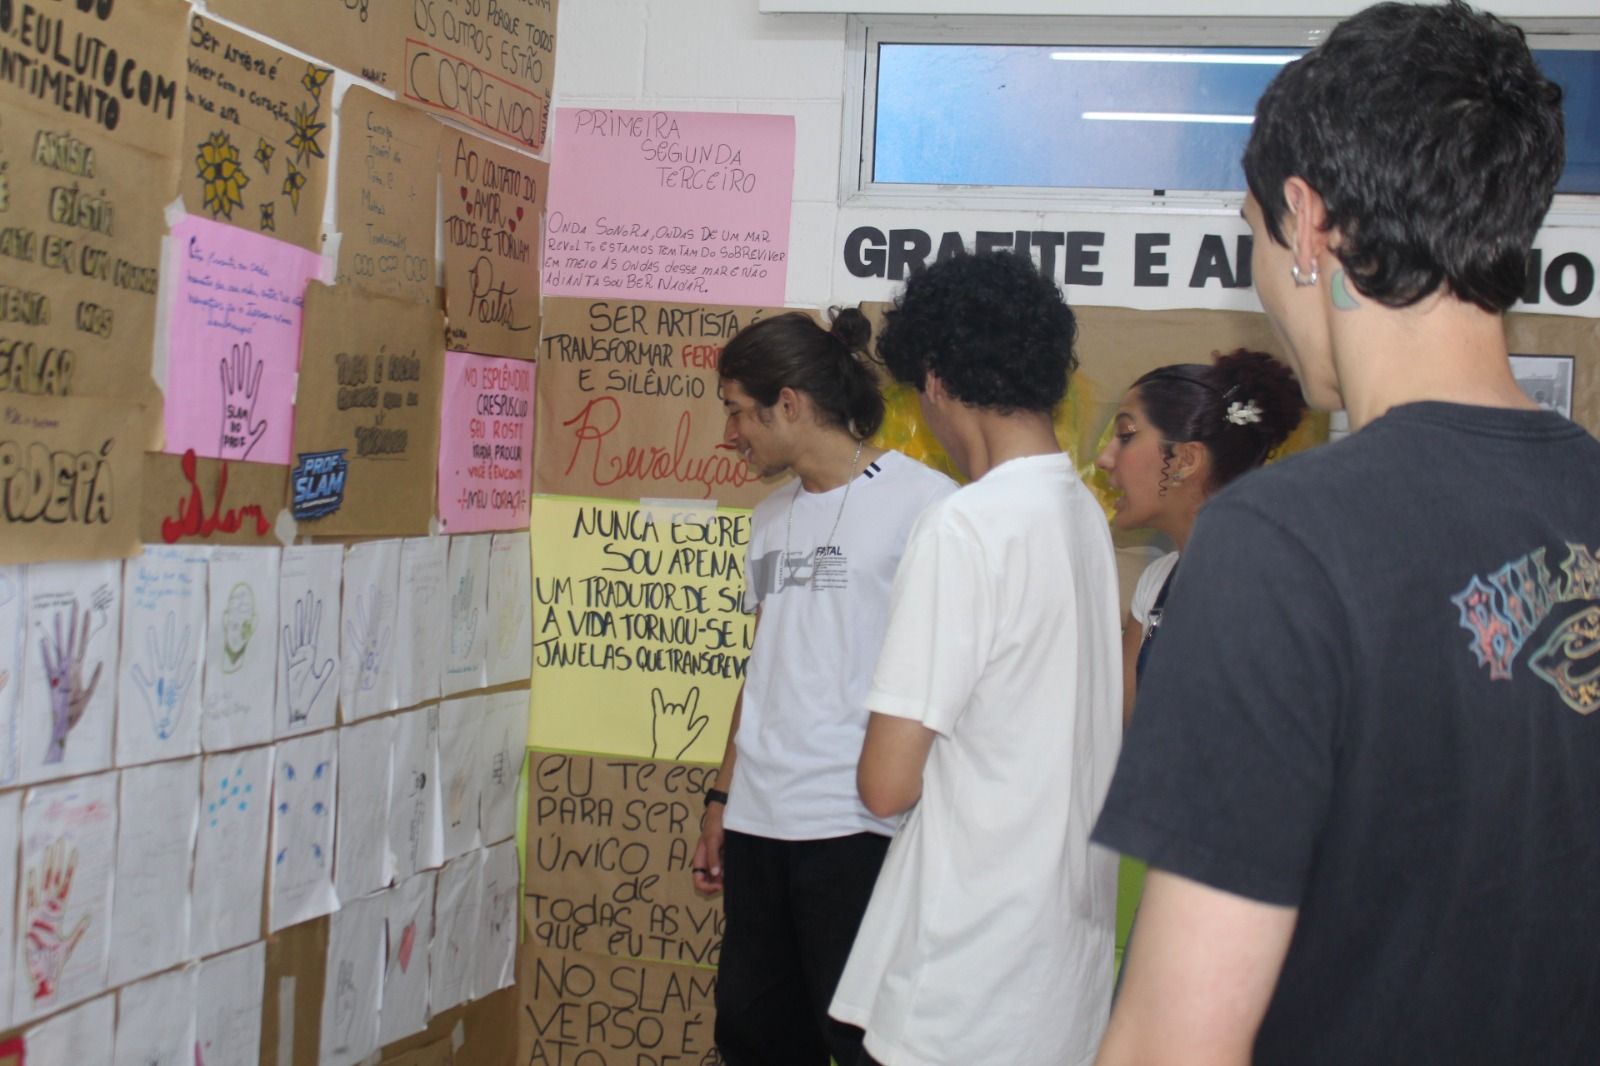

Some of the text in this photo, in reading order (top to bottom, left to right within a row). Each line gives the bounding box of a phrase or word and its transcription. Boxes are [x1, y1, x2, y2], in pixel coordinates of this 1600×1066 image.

[442, 10, 494, 61] OUTROS
[501, 41, 543, 84] ESTÃO
[525, 23, 554, 53] TODOS
[21, 4, 52, 54] EU
[53, 19, 118, 87] LUTO
[120, 58, 177, 120] COM
[455, 137, 537, 204] AO CONTATO DO
[473, 188, 506, 229] AMOR
[1134, 233, 1171, 287] E
[589, 302, 648, 337] SER
[657, 307, 740, 339] ARTISTA
[542, 333, 673, 369] TRANSFORMAR
[579, 369, 595, 392] E
[226, 403, 249, 420] SLAM
[295, 470, 345, 503] SLAM
[573, 507, 754, 548] NUNCA ESCRE
[602, 543, 663, 576] SOU
[668, 548, 747, 581] APENA
[815, 546, 842, 556] FATAL
[536, 576, 574, 606] UM
[579, 575, 678, 611] TRADUTOR
[683, 586, 711, 614] DE
[541, 606, 562, 636] A
[567, 610, 617, 639] VIDA
[619, 613, 737, 650] TORNOU-SE
[534, 636, 633, 672] JANELAS
[636, 646, 667, 673] QUE
[537, 796, 614, 827] PARA
[650, 903, 680, 936] AS
[534, 956, 718, 1014] NO SLAM
[524, 1001, 704, 1055] VERSO É
